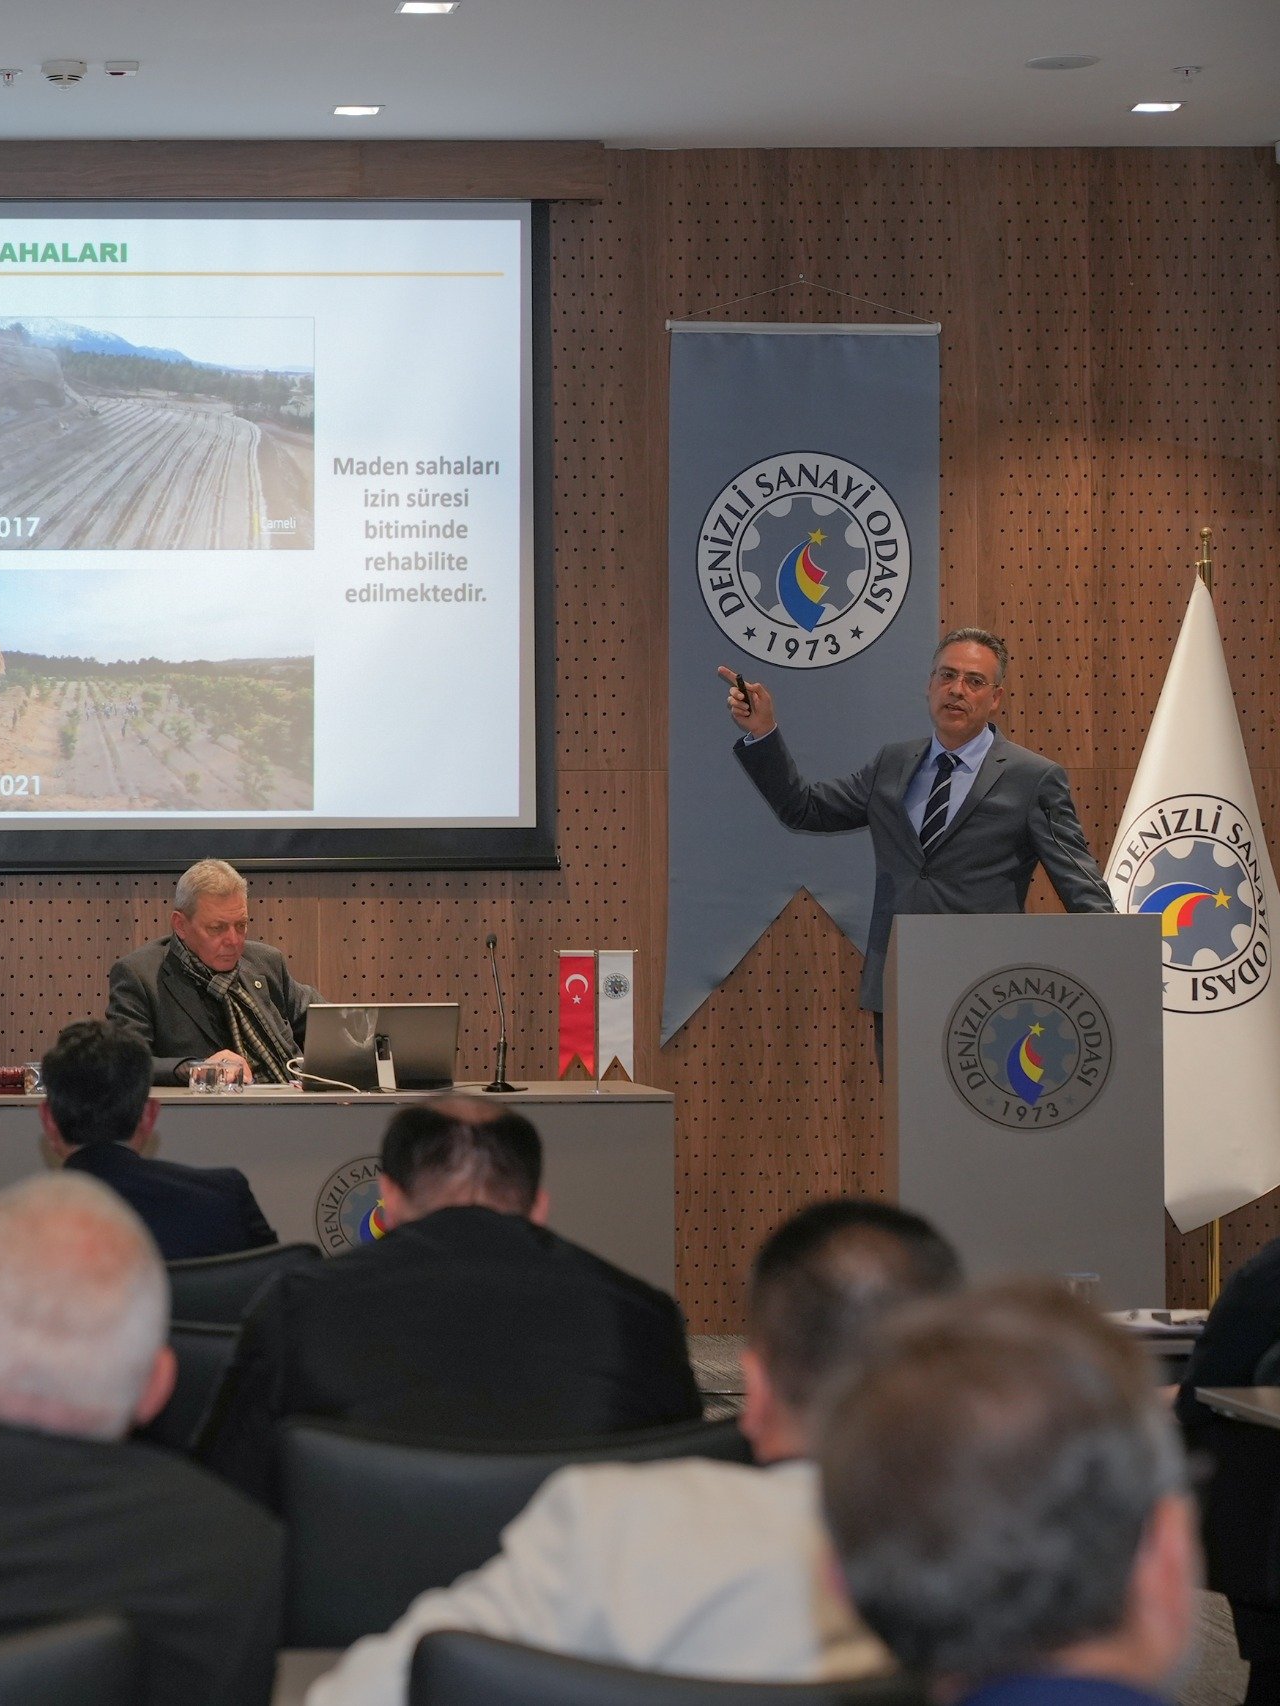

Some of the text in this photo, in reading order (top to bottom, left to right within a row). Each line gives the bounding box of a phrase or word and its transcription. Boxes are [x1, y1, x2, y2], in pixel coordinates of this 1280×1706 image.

[333, 455, 500, 476] Maden sahaları
[364, 488, 469, 508] izin süresi
[364, 518, 468, 540] bitiminde
[703, 463, 899, 618] DENİZLİ SANAYİ ODASI
[365, 551, 468, 571] rehabilite
[345, 582, 487, 603] edilmektedir.
[766, 630, 841, 661] 1973
[1115, 805, 1223, 884] DENİZLİ
[953, 977, 1103, 1091] DENİZLİ SANAYİ ODASI
[1002, 1100, 1059, 1122] 1973
